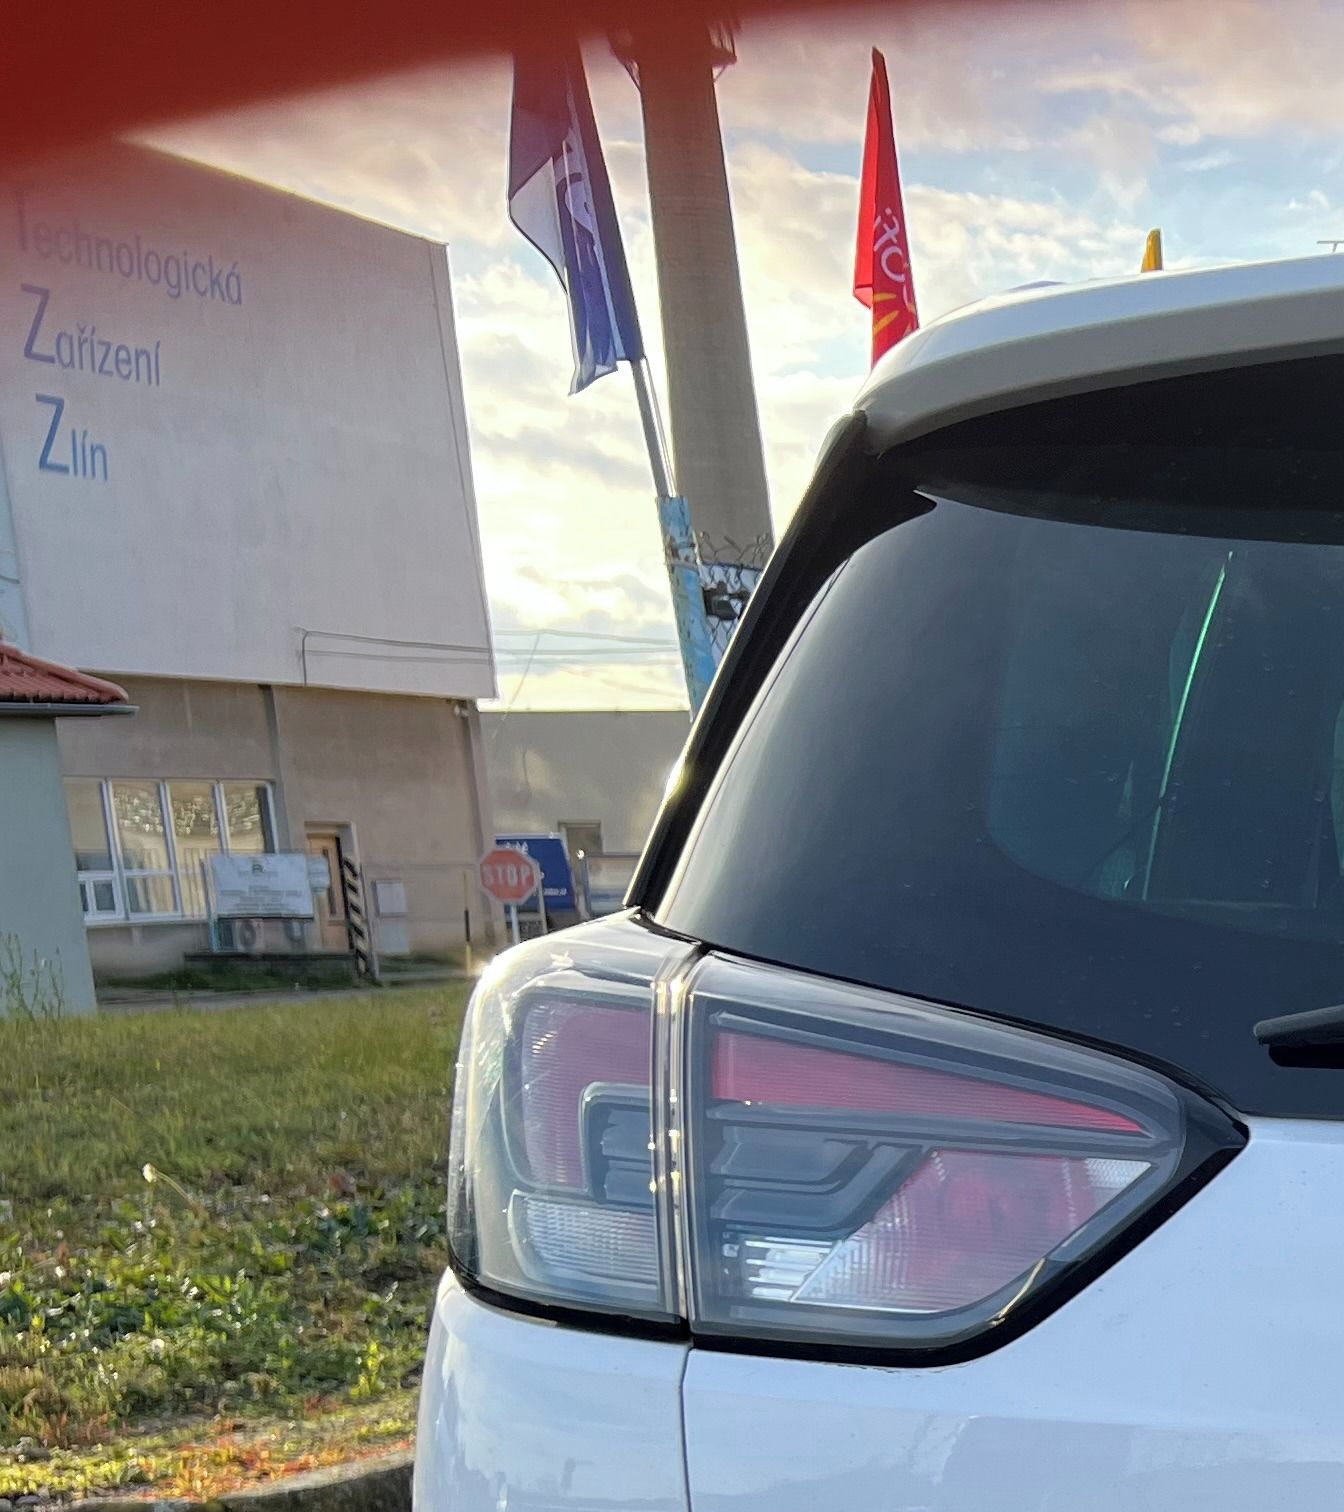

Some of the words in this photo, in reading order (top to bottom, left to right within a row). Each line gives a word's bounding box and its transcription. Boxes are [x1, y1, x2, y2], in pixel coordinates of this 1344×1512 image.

[13, 183, 243, 306] Technologická
[20, 283, 161, 387] Zařízení
[35, 393, 109, 482] Zlín
[482, 863, 530, 888] STOP
